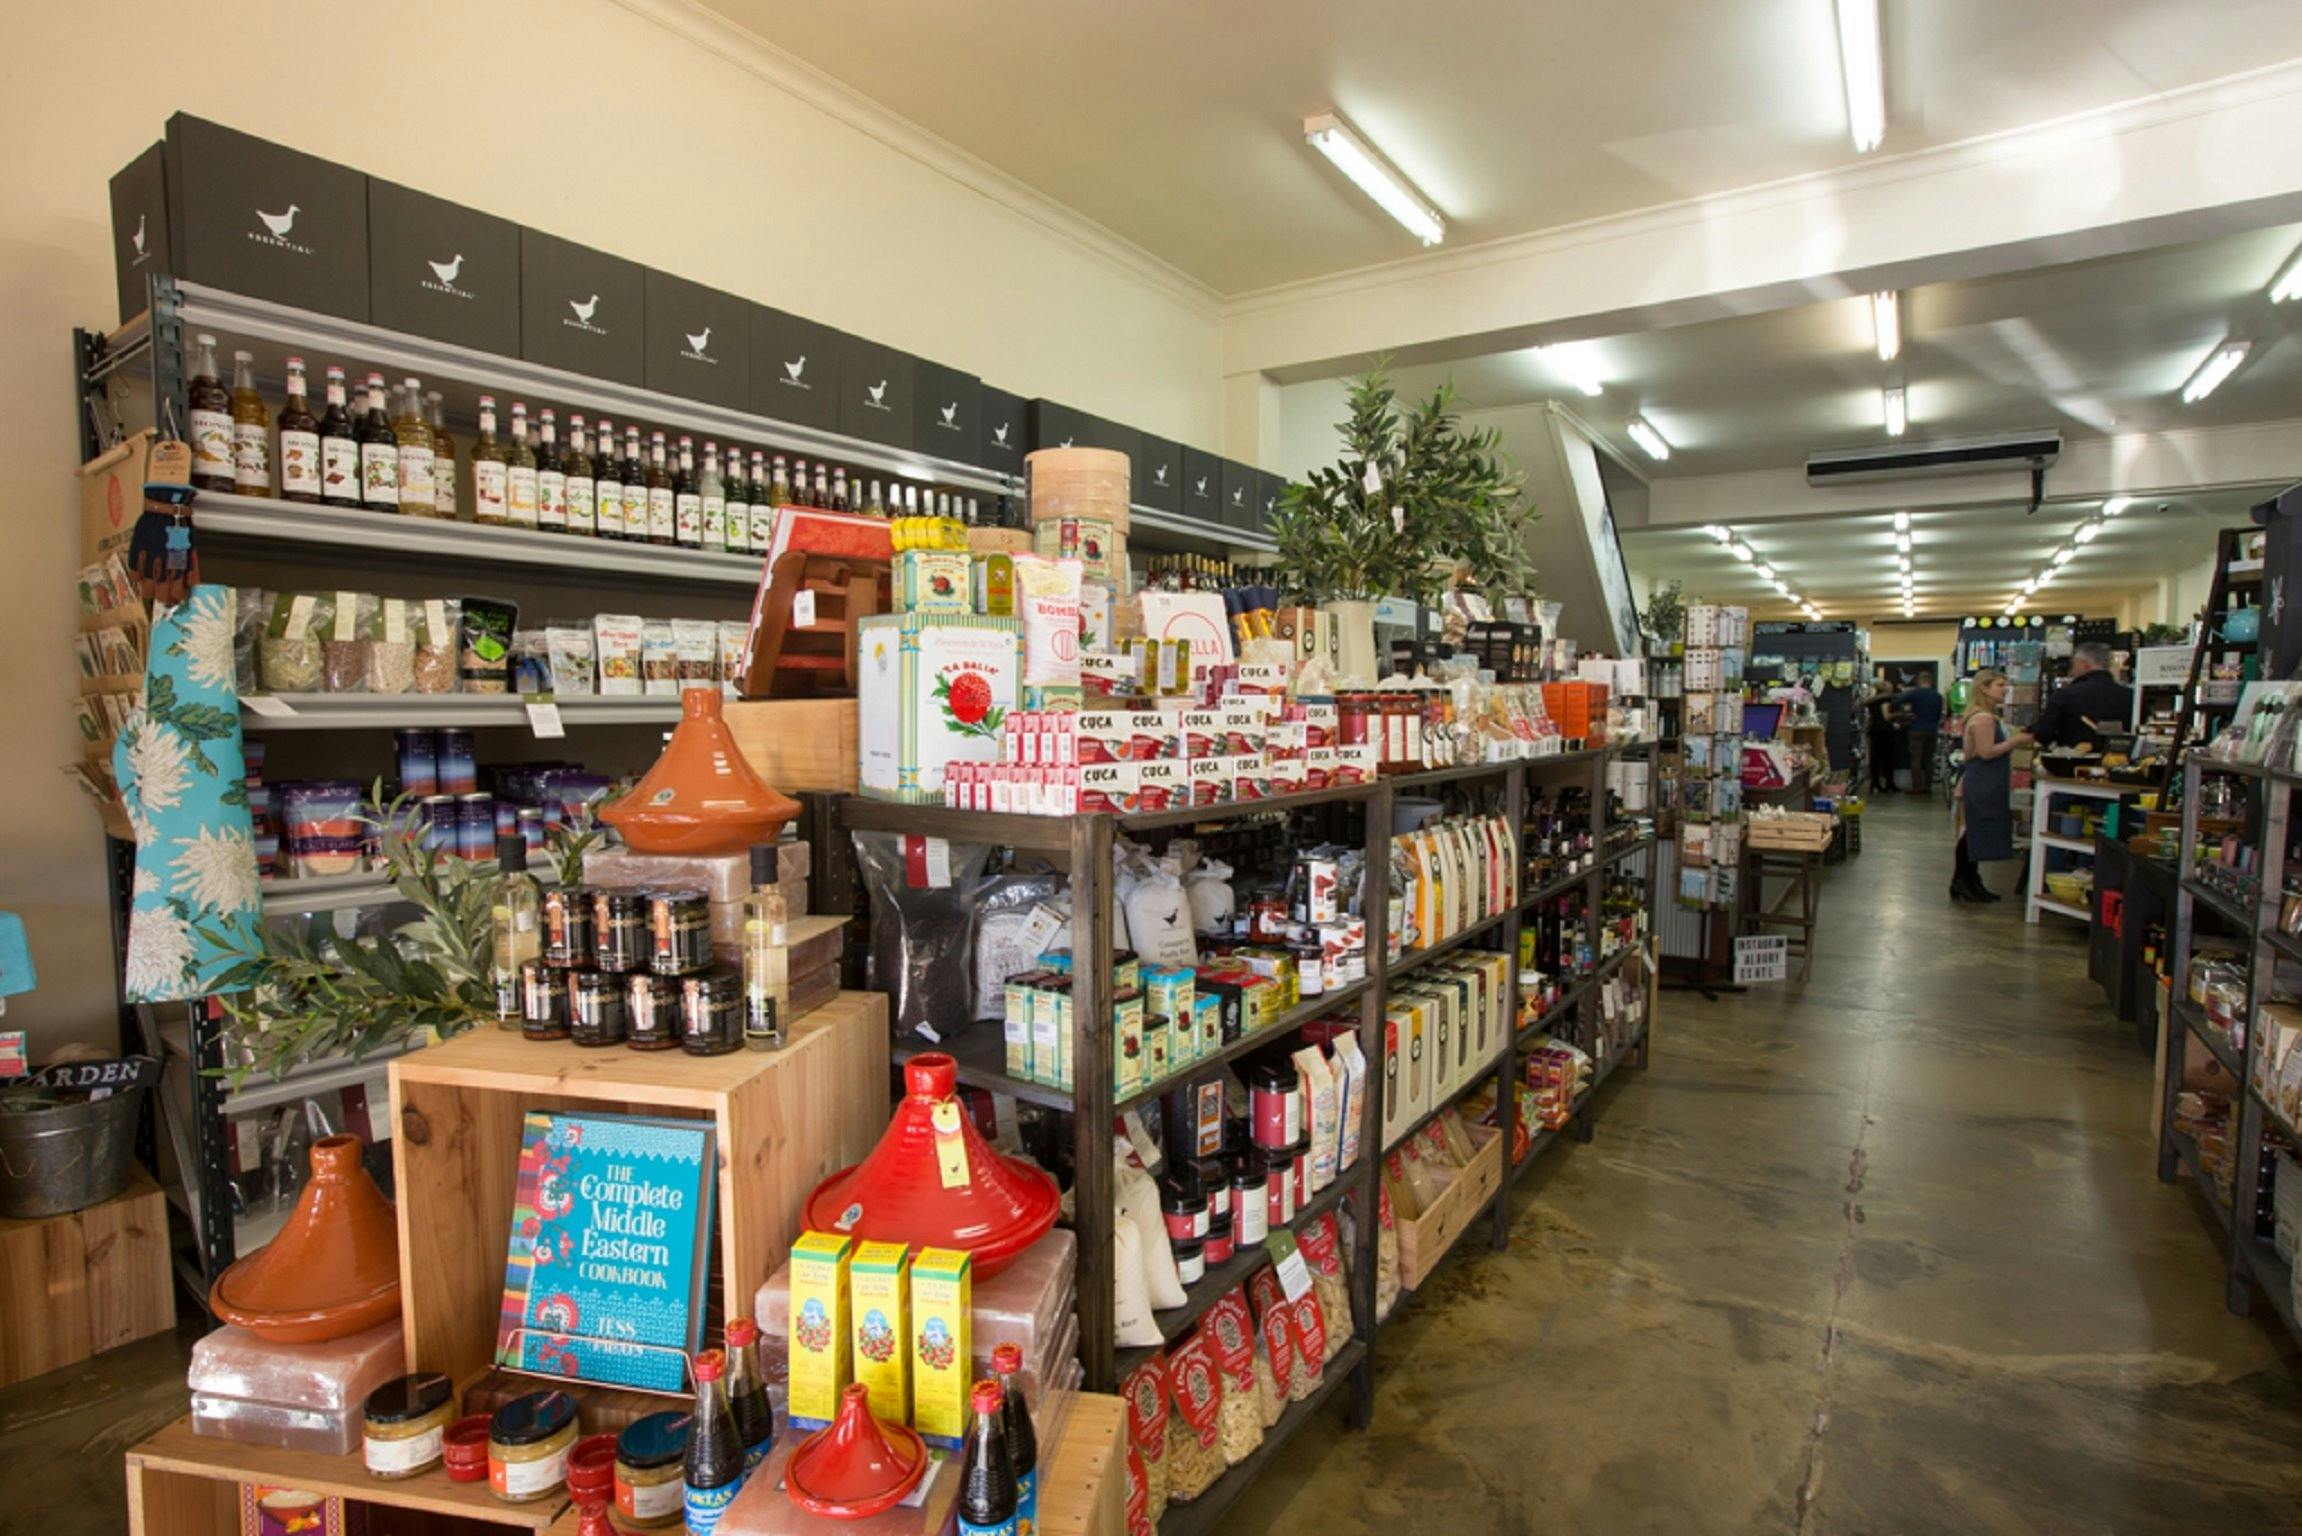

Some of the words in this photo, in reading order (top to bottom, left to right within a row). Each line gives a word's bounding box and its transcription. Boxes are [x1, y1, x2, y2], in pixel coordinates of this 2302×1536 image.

[1241, 666, 1270, 677] CUCA
[1308, 708, 1327, 718] CUCA
[1079, 716, 1112, 729] CUCA
[1132, 715, 1163, 727] CUCA
[1185, 714, 1212, 726] CUCA
[1226, 714, 1250, 725] CUCA
[1311, 749, 1330, 761] CUCA
[1338, 749, 1362, 760] CUCA
[1194, 762, 1219, 774] CUCA
[1236, 758, 1260, 771] CUCA
[1084, 769, 1118, 782] CUCA
[1141, 766, 1171, 778] CUCA
[28, 1061, 141, 1088] ARDEN
[607, 1164, 634, 1183] THE
[580, 1173, 683, 1210] Complete
[590, 1200, 667, 1239] Middle
[582, 1228, 669, 1267] Eastern
[579, 1261, 668, 1290] COOKBOOK
